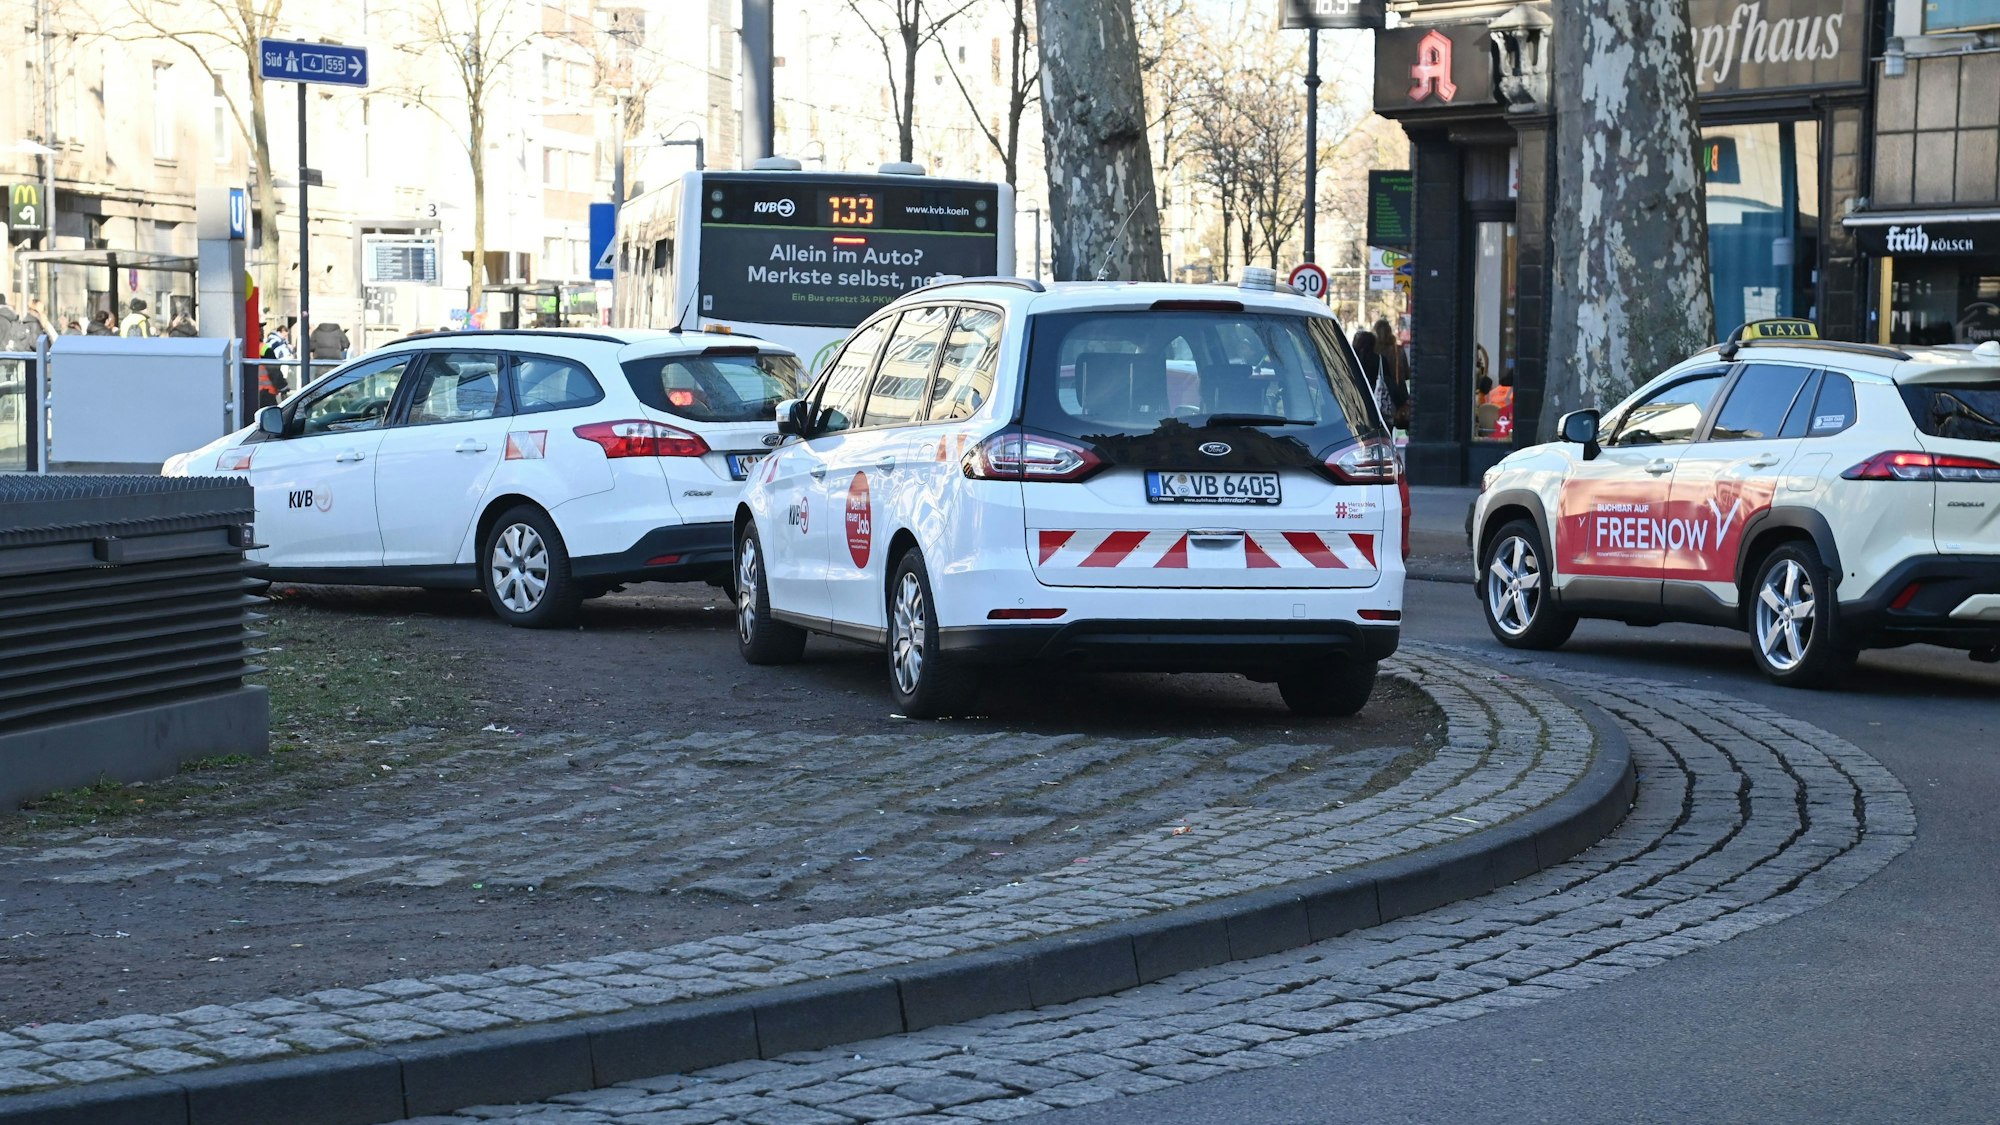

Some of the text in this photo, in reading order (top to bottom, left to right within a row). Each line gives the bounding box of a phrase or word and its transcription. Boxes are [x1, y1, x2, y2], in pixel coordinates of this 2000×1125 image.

[265, 51, 344, 71] Süd 4 555
[231, 195, 243, 233] U
[428, 203, 437, 218] 3
[754, 201, 777, 213] KVB
[829, 196, 874, 225] 133
[905, 205, 970, 216] www.kvb.koeln
[1886, 224, 1974, 254] früh KÖLSCH
[770, 244, 924, 266] Allein im Auto?
[747, 265, 833, 285] Merkste
[838, 269, 905, 290] selbst,
[1296, 275, 1319, 293] 30
[792, 293, 896, 304] Ein Bus ersetzt 34 PKW
[1765, 324, 1805, 336] TAXI
[1207, 444, 1225, 454] Ford
[738, 457, 749, 473] K
[1161, 475, 1176, 495] K
[1190, 475, 1219, 496] VB
[1223, 476, 1276, 496] 6405
[288, 489, 313, 509] KVB
[1597, 504, 1650, 513] BUCHBAR AUF
[789, 505, 801, 526] KVB
[857, 513, 870, 535] Job
[1597, 517, 1708, 551] FREENOW
